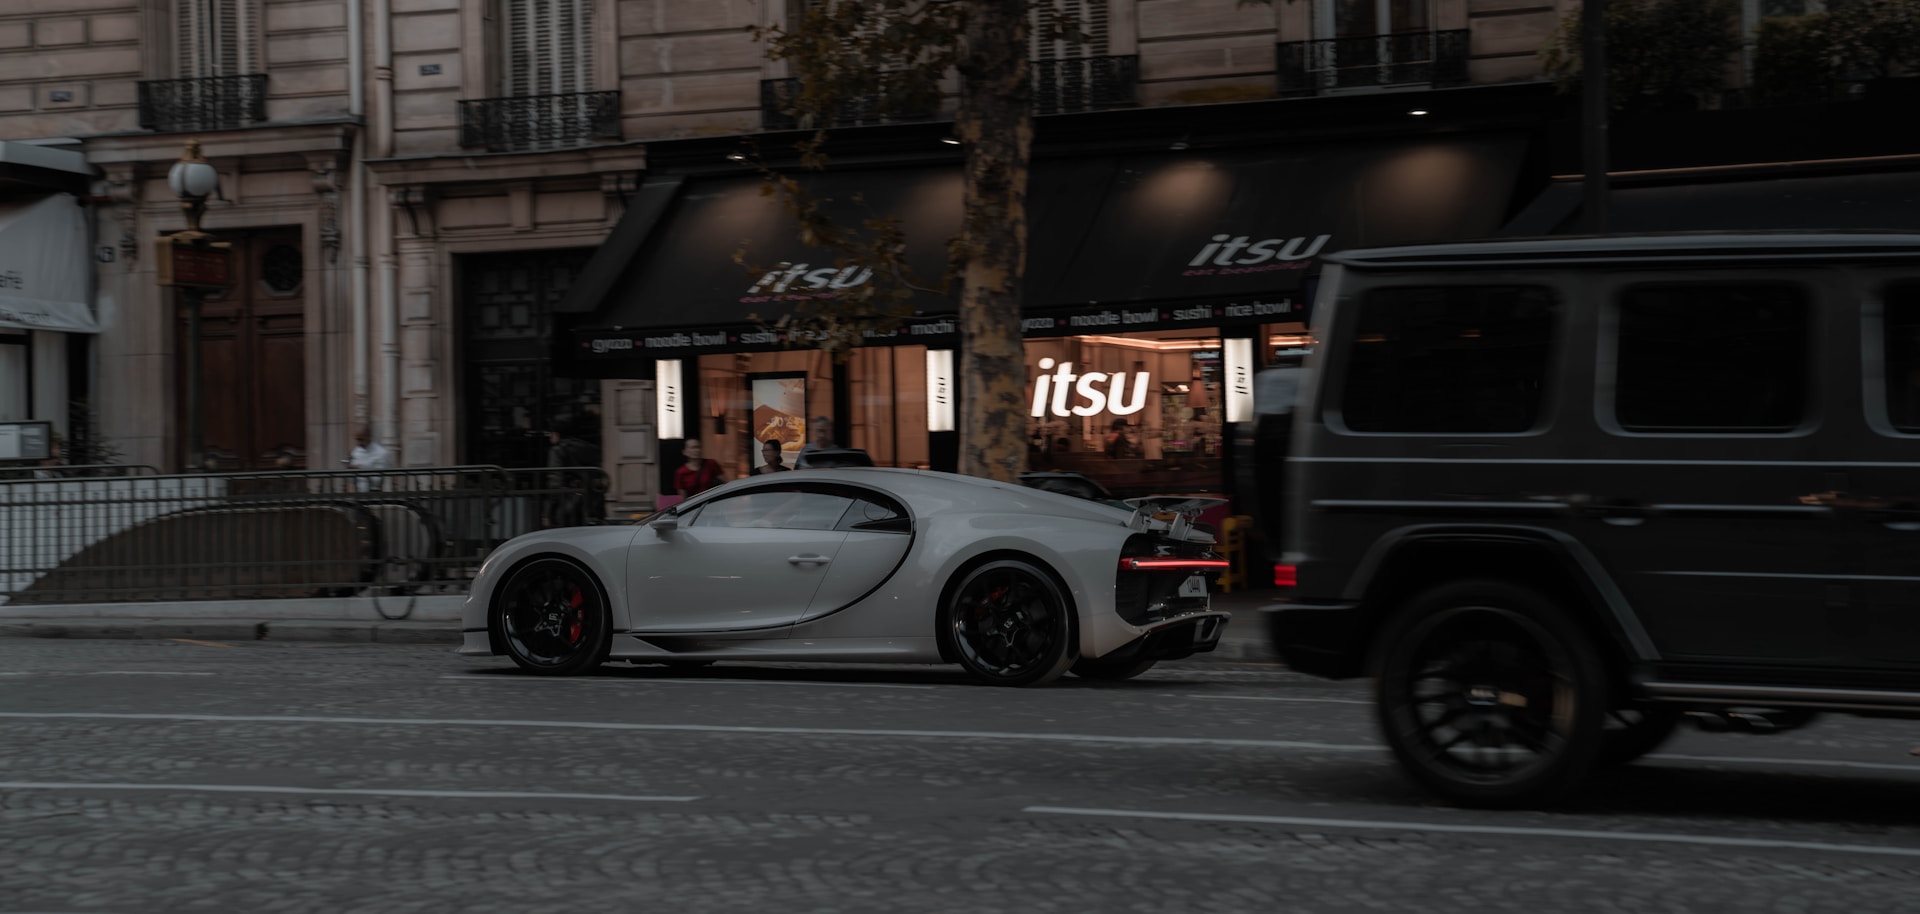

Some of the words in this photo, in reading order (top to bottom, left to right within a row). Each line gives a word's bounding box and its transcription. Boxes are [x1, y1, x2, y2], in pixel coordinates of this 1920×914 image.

[1188, 233, 1332, 267] itsu
[747, 261, 874, 294] itsu
[1020, 316, 1055, 333] yoza
[1069, 310, 1121, 327] noodle
[1121, 307, 1159, 325] bowl
[1172, 304, 1213, 321] sushi
[1225, 302, 1254, 317] rice
[1253, 298, 1291, 315] bowl
[644, 332, 692, 348] noodle
[691, 330, 727, 346] bowl
[1030, 357, 1150, 417] itsu
